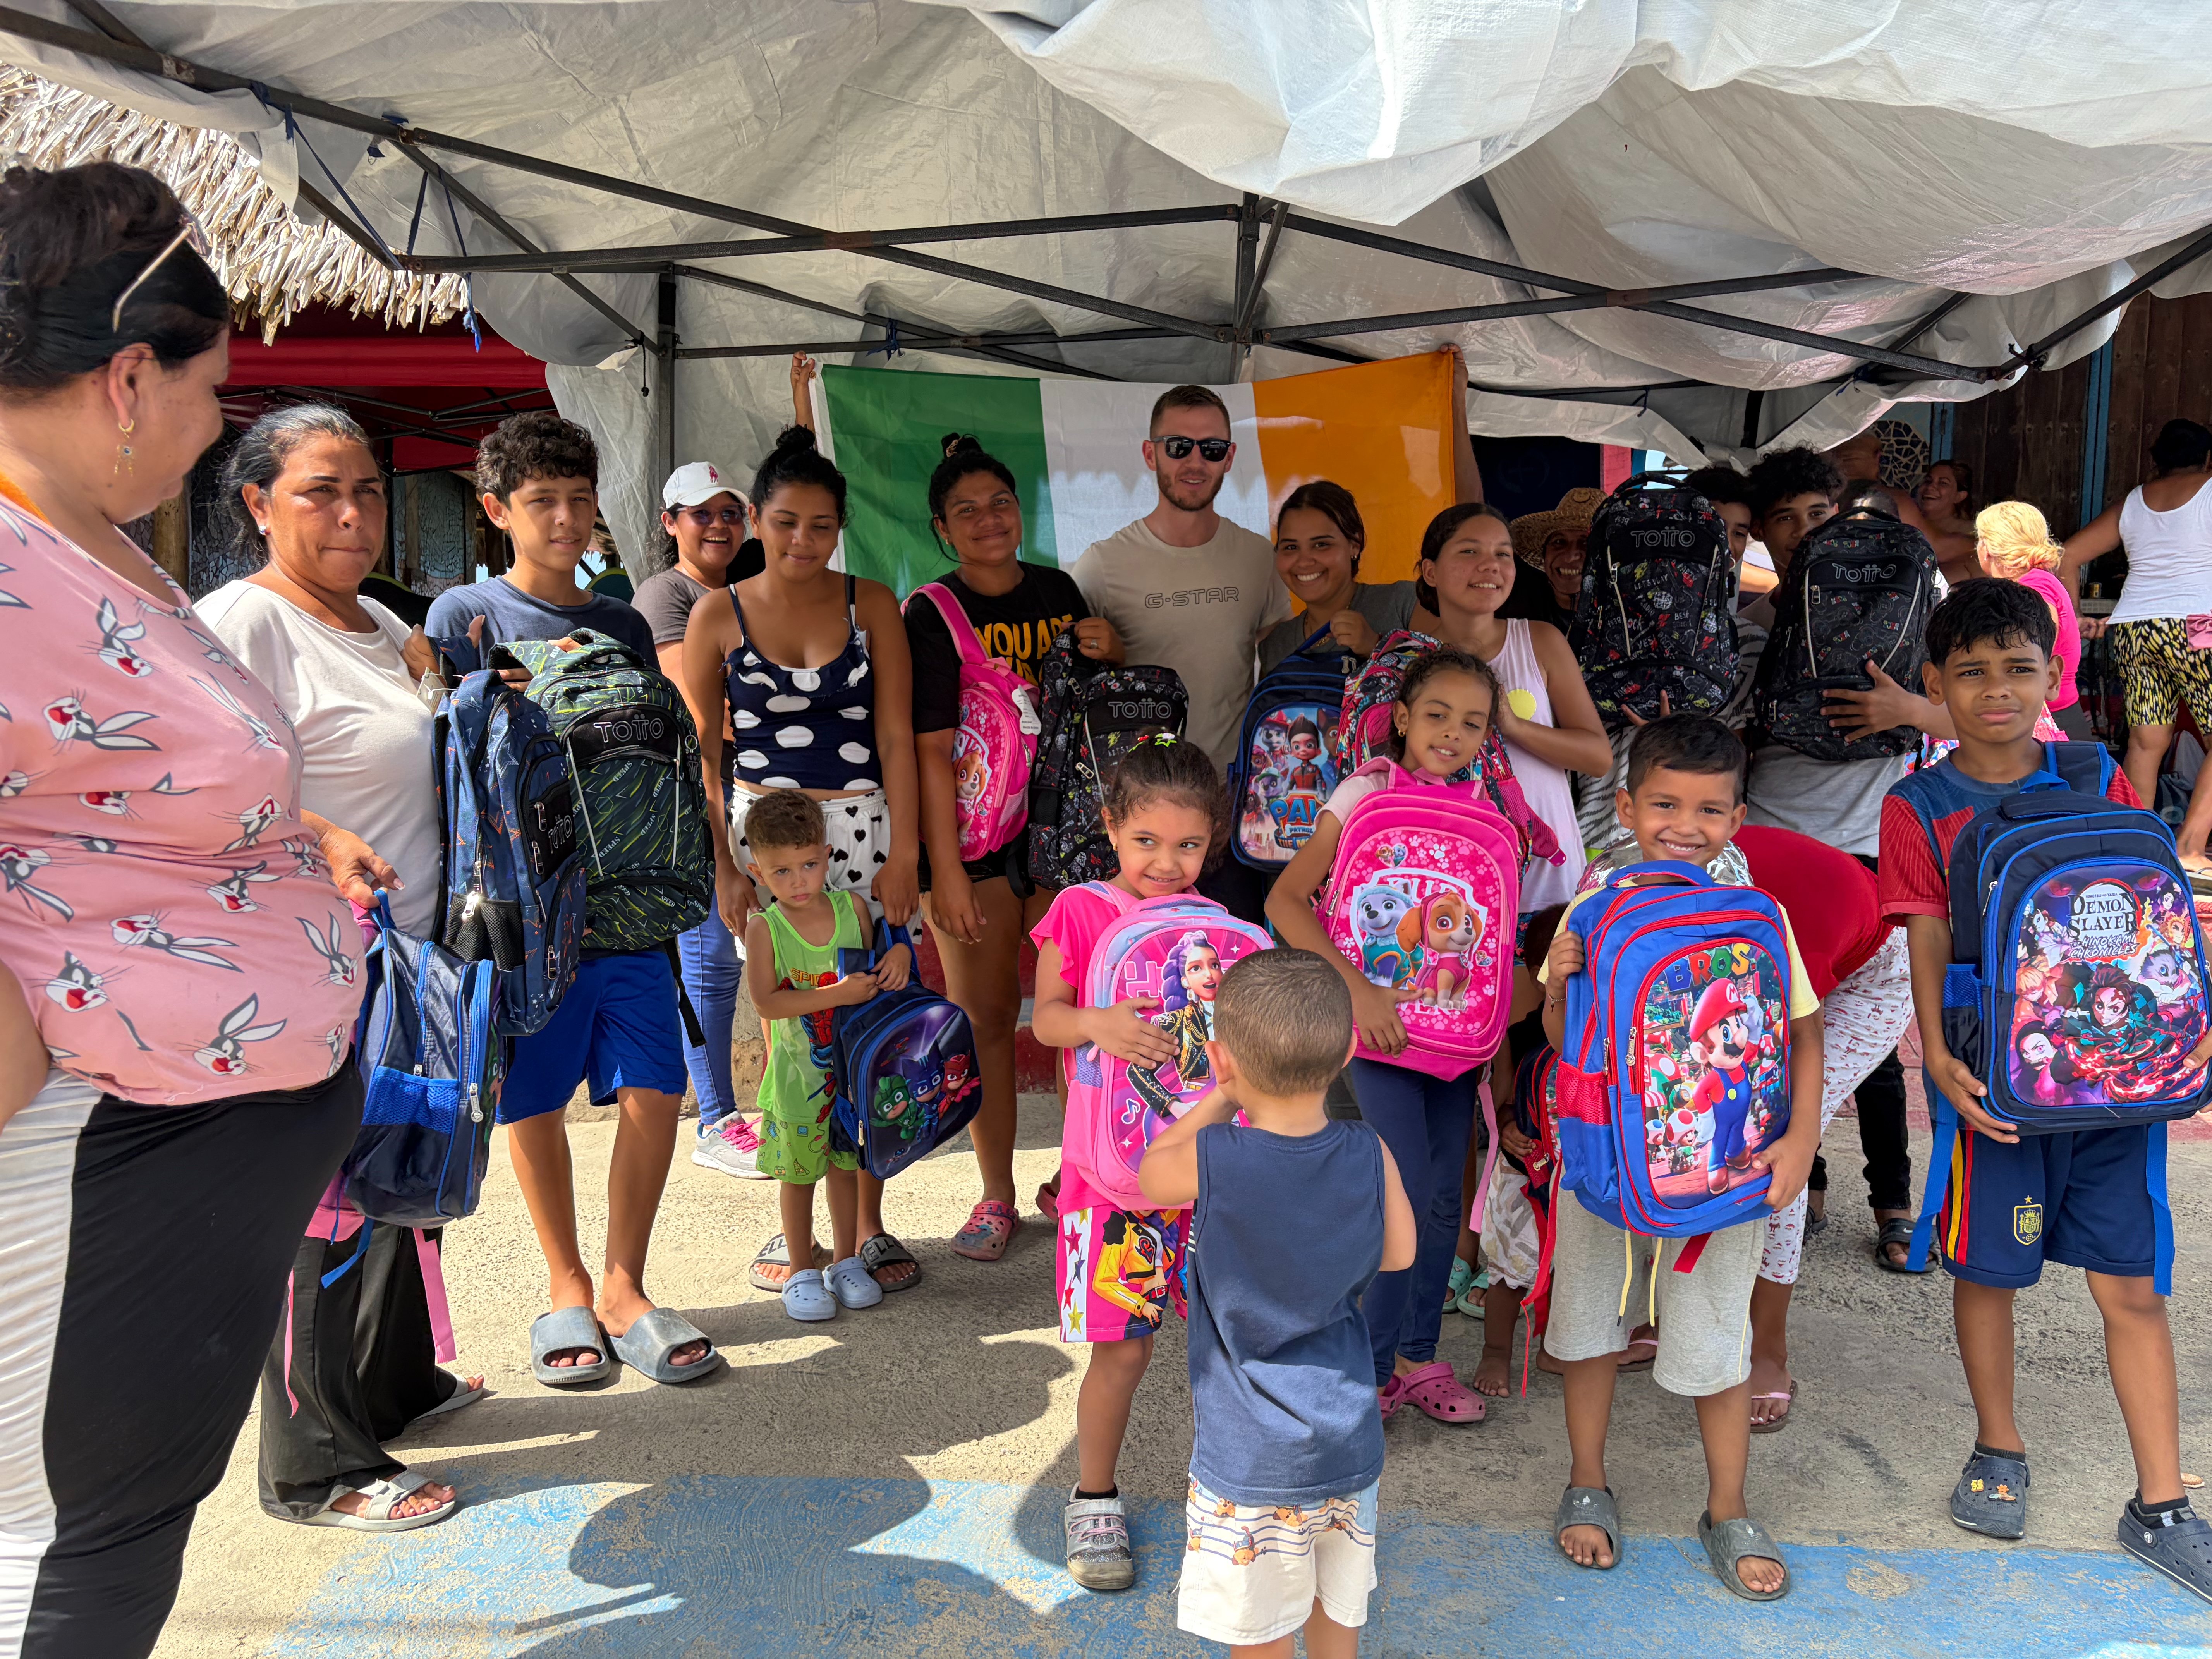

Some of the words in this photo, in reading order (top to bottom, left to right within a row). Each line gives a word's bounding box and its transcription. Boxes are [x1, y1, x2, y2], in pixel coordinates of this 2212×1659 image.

[1630, 526, 1695, 548] TOTTO
[1832, 563, 1897, 582] TOTTO
[1145, 587, 1239, 609] G-STAR
[975, 622, 1031, 660] YOU
[1037, 613, 1073, 659] AR
[1108, 697, 1171, 719] TOTTO
[593, 714, 664, 743] TOTTO
[613, 760, 633, 782] SPEED
[653, 776, 665, 798] SPEED
[641, 813, 656, 836] SPEED
[599, 836, 620, 858] SPEED
[661, 895, 676, 907] SPEED
[2068, 892, 2138, 917] DEMON
[2068, 912, 2138, 939] SLAYER
[2082, 932, 2137, 947] HINOKAMI
[2071, 943, 2138, 959] CHRONICLES
